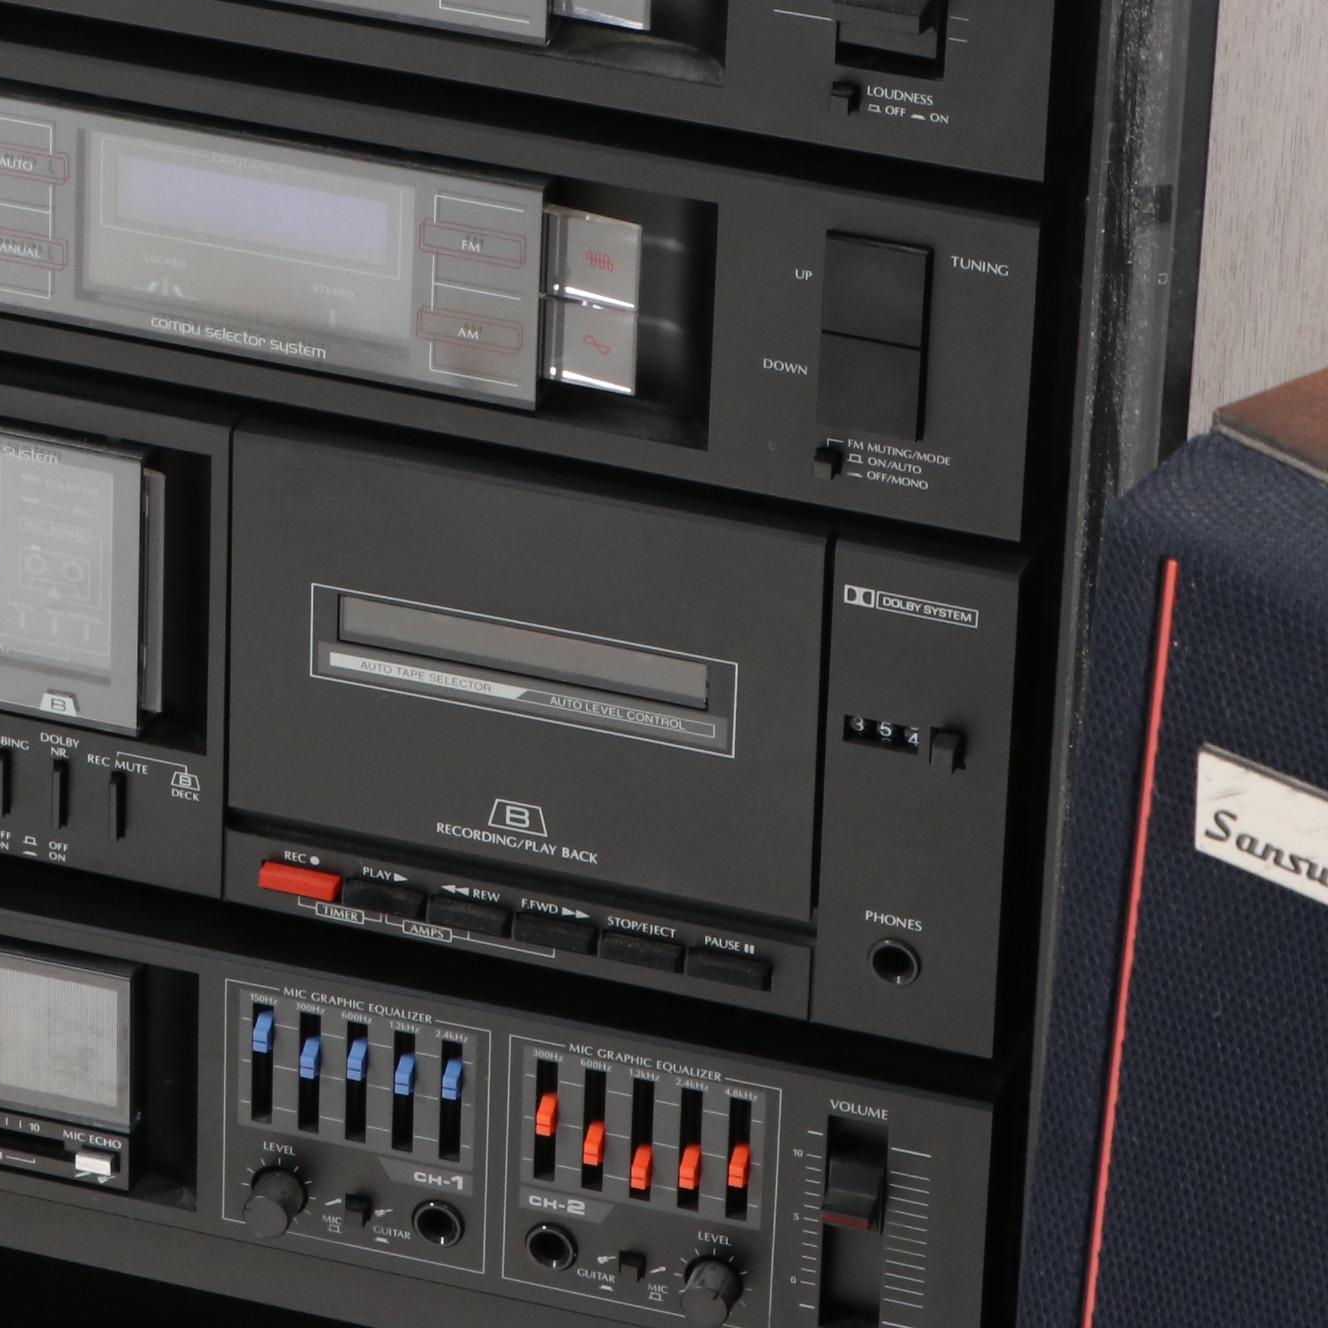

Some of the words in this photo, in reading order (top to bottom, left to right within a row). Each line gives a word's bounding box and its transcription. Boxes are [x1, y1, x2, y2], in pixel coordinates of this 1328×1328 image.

[867, 85, 933, 106] LOUDNESS
[0, 157, 33, 171] AUTO
[461, 239, 481, 252] FM
[795, 269, 812, 281] UP
[951, 255, 1009, 277] TUNING
[150, 316, 201, 337] compu
[205, 325, 266, 348] selector
[270, 338, 326, 359] system
[458, 328, 479, 340] AM
[763, 359, 808, 375] DOWN
[847, 438, 864, 450] FM
[867, 442, 951, 466] MUTING/MODE
[868, 457, 922, 474] ON/AUTO
[867, 471, 928, 489] OFF/MONO
[882, 596, 921, 613] DOLBY
[924, 603, 972, 623] SYSTEM
[360, 659, 392, 676] AUTO
[395, 666, 425, 681] TAPE
[429, 673, 492, 693] SELECTOR
[550, 695, 582, 712] AUTO
[585, 702, 623, 718] LEVEL
[626, 709, 685, 730] CONTROL
[40, 732, 79, 749] DOLBY
[87, 753, 110, 767] REC
[115, 759, 148, 774] MUTE
[172, 788, 199, 801] DECK
[437, 822, 557, 858] RECORDING/PLAY
[561, 846, 598, 864] BACK
[283, 849, 307, 864] REC
[362, 866, 392, 881] PLAY
[473, 886, 500, 902] REW
[607, 915, 677, 938] STOP/EJECT
[865, 910, 922, 931] PHONES
[704, 935, 741, 952] PAUSE
[283, 987, 308, 999] MIC
[311, 992, 364, 1011] GRAPHIC
[368, 1003, 432, 1024] EQUALIZER
[569, 1043, 593, 1057] MIC
[597, 1047, 652, 1069] GRAPHIC
[656, 1059, 722, 1082] EQUALIZER
[830, 1099, 888, 1121] VOLUME
[263, 1141, 295, 1156] LEVEL
[414, 1172, 464, 1190] CH-1
[528, 1194, 586, 1215] CH-2
[697, 1230, 731, 1246] LEVEL
